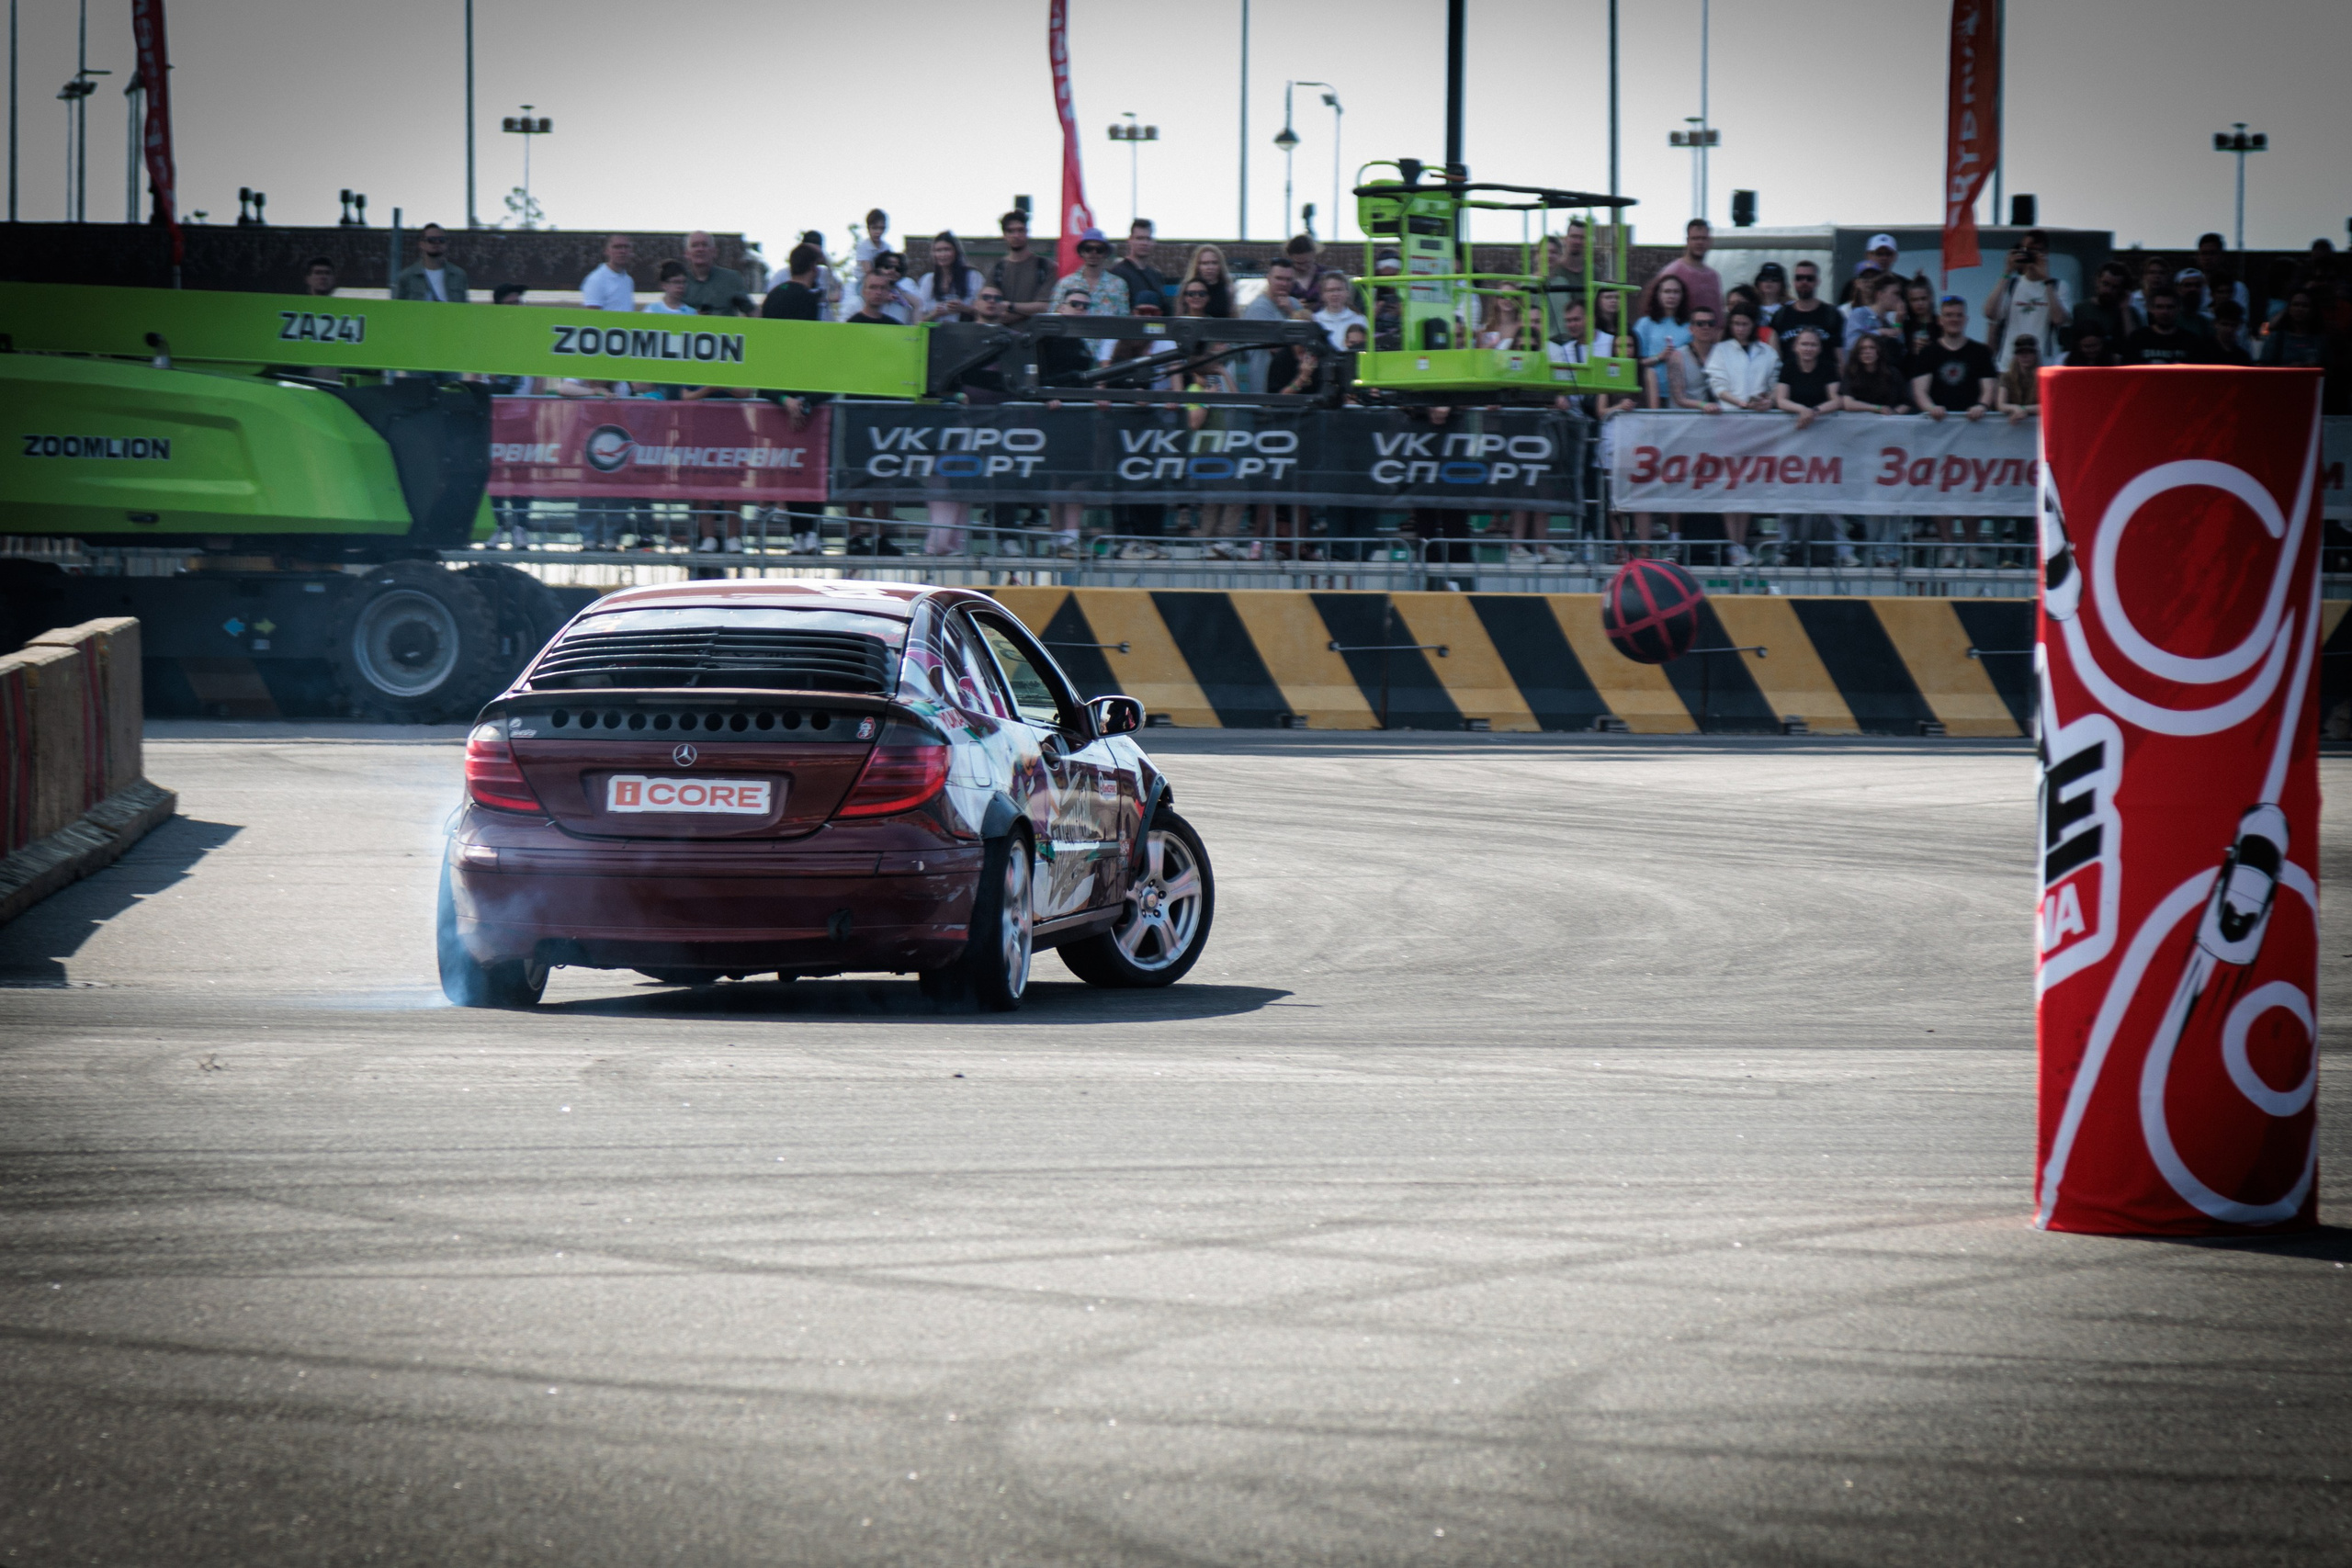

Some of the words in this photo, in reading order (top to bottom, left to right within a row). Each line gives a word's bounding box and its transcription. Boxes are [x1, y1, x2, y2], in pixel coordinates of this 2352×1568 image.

[279, 311, 366, 344] ZA24J
[552, 325, 745, 364] ZOOMLION
[22, 434, 172, 460] ZOOMLION
[868, 426, 933, 450] VK
[936, 427, 1046, 451] ПРО
[1118, 429, 1186, 453] VK
[1189, 430, 1298, 454] ПРО
[1371, 432, 1438, 457] VK
[1441, 433, 1552, 459] ПРО
[634, 446, 807, 468] ШИНСЕРВИС
[865, 454, 1046, 478] СПОРТ
[1116, 457, 1297, 480] СПОРТ
[1370, 459, 1551, 486] СПОРТ
